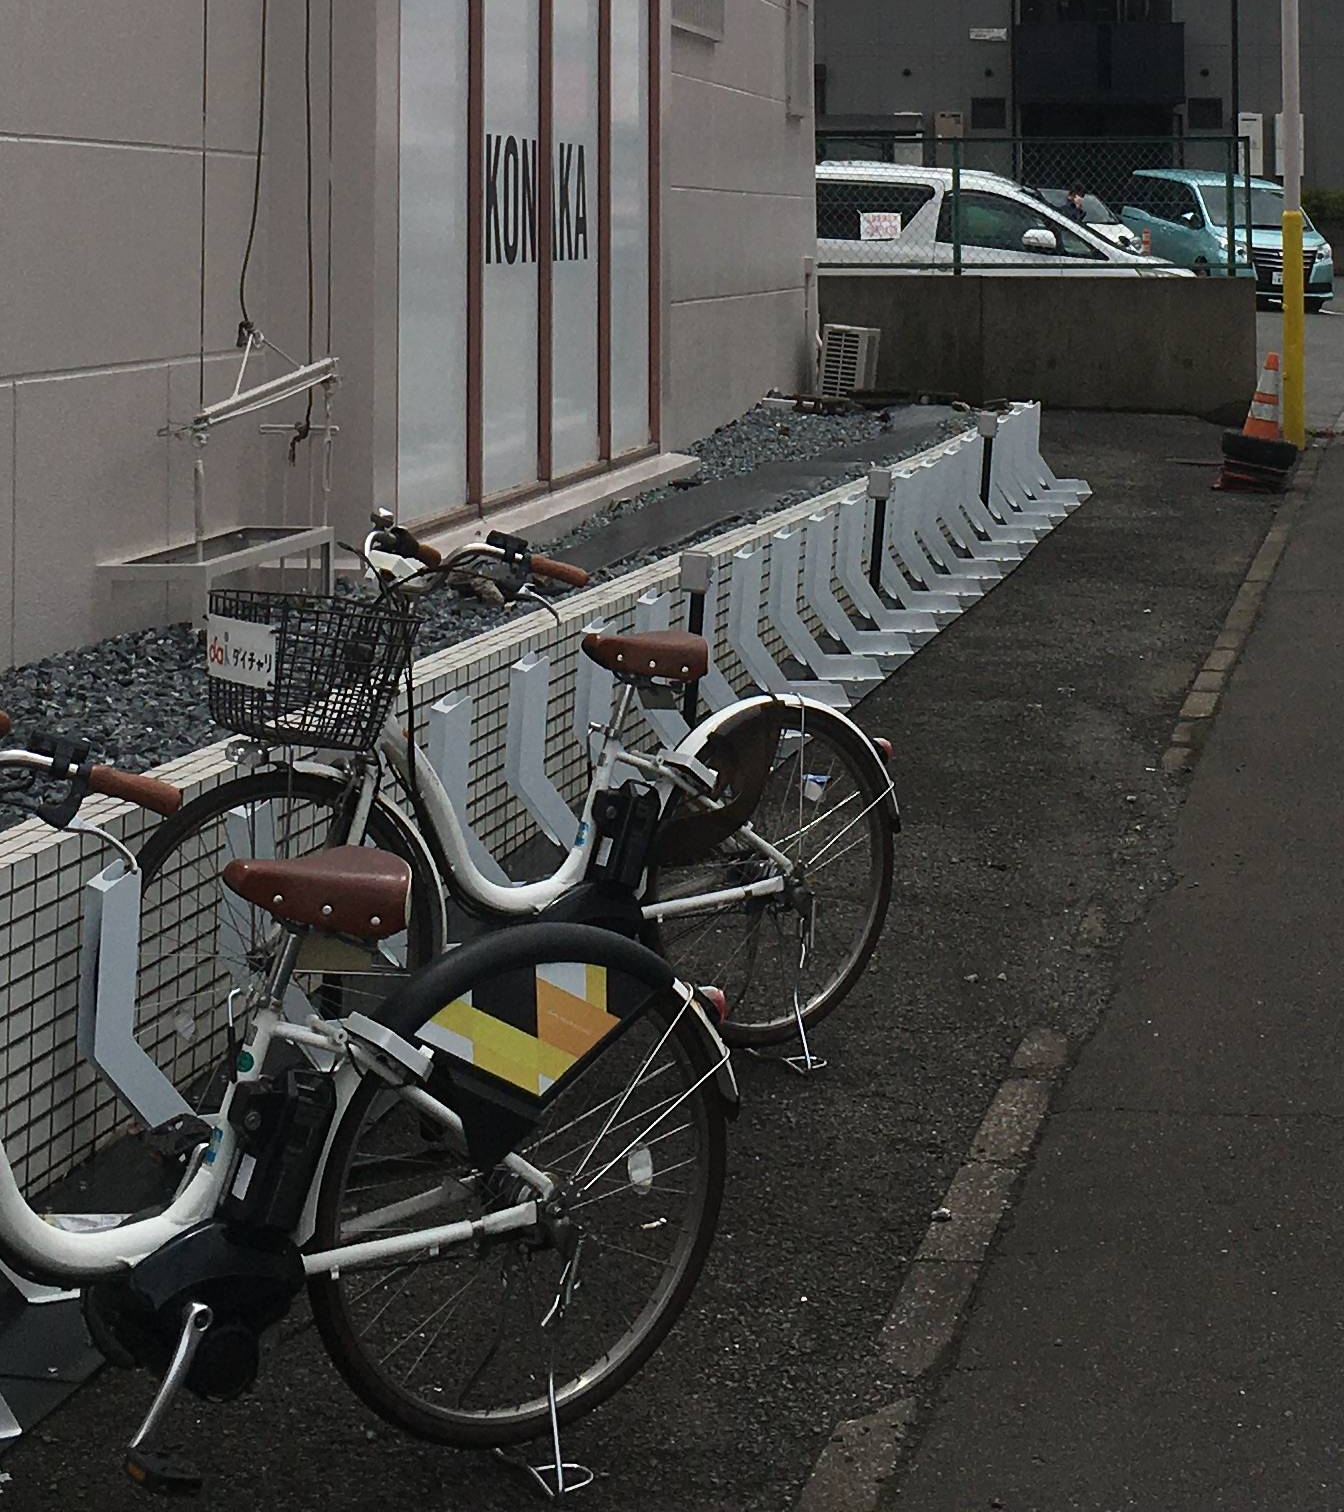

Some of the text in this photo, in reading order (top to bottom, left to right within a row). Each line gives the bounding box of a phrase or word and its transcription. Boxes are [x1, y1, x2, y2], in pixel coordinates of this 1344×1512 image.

[485, 134, 588, 265] KONKA
[232, 647, 273, 674] ダイチャリ
